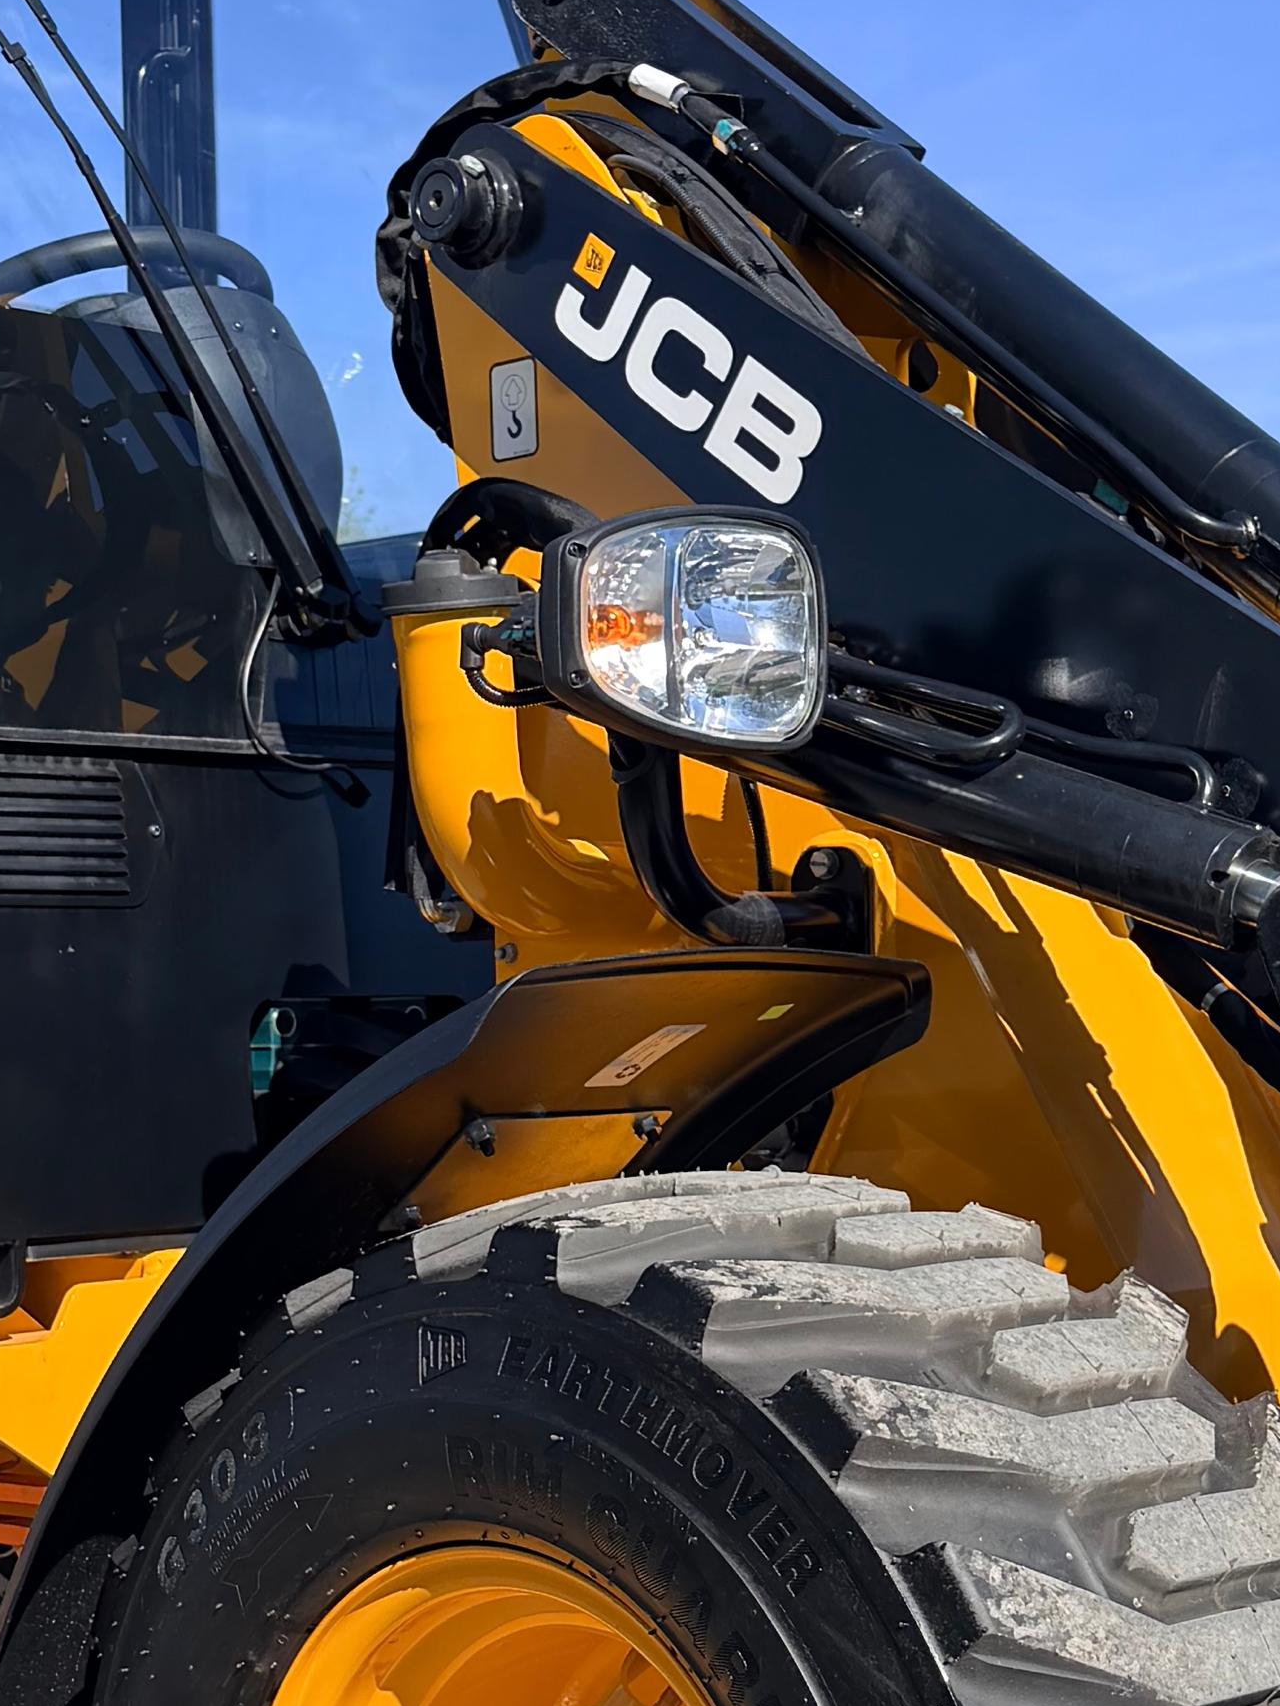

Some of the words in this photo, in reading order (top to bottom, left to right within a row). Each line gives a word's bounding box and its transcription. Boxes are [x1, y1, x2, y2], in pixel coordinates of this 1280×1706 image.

[555, 264, 822, 505] JCB
[445, 1432, 564, 1527] RIM
[495, 1333, 823, 1598] EARTHMOVER
